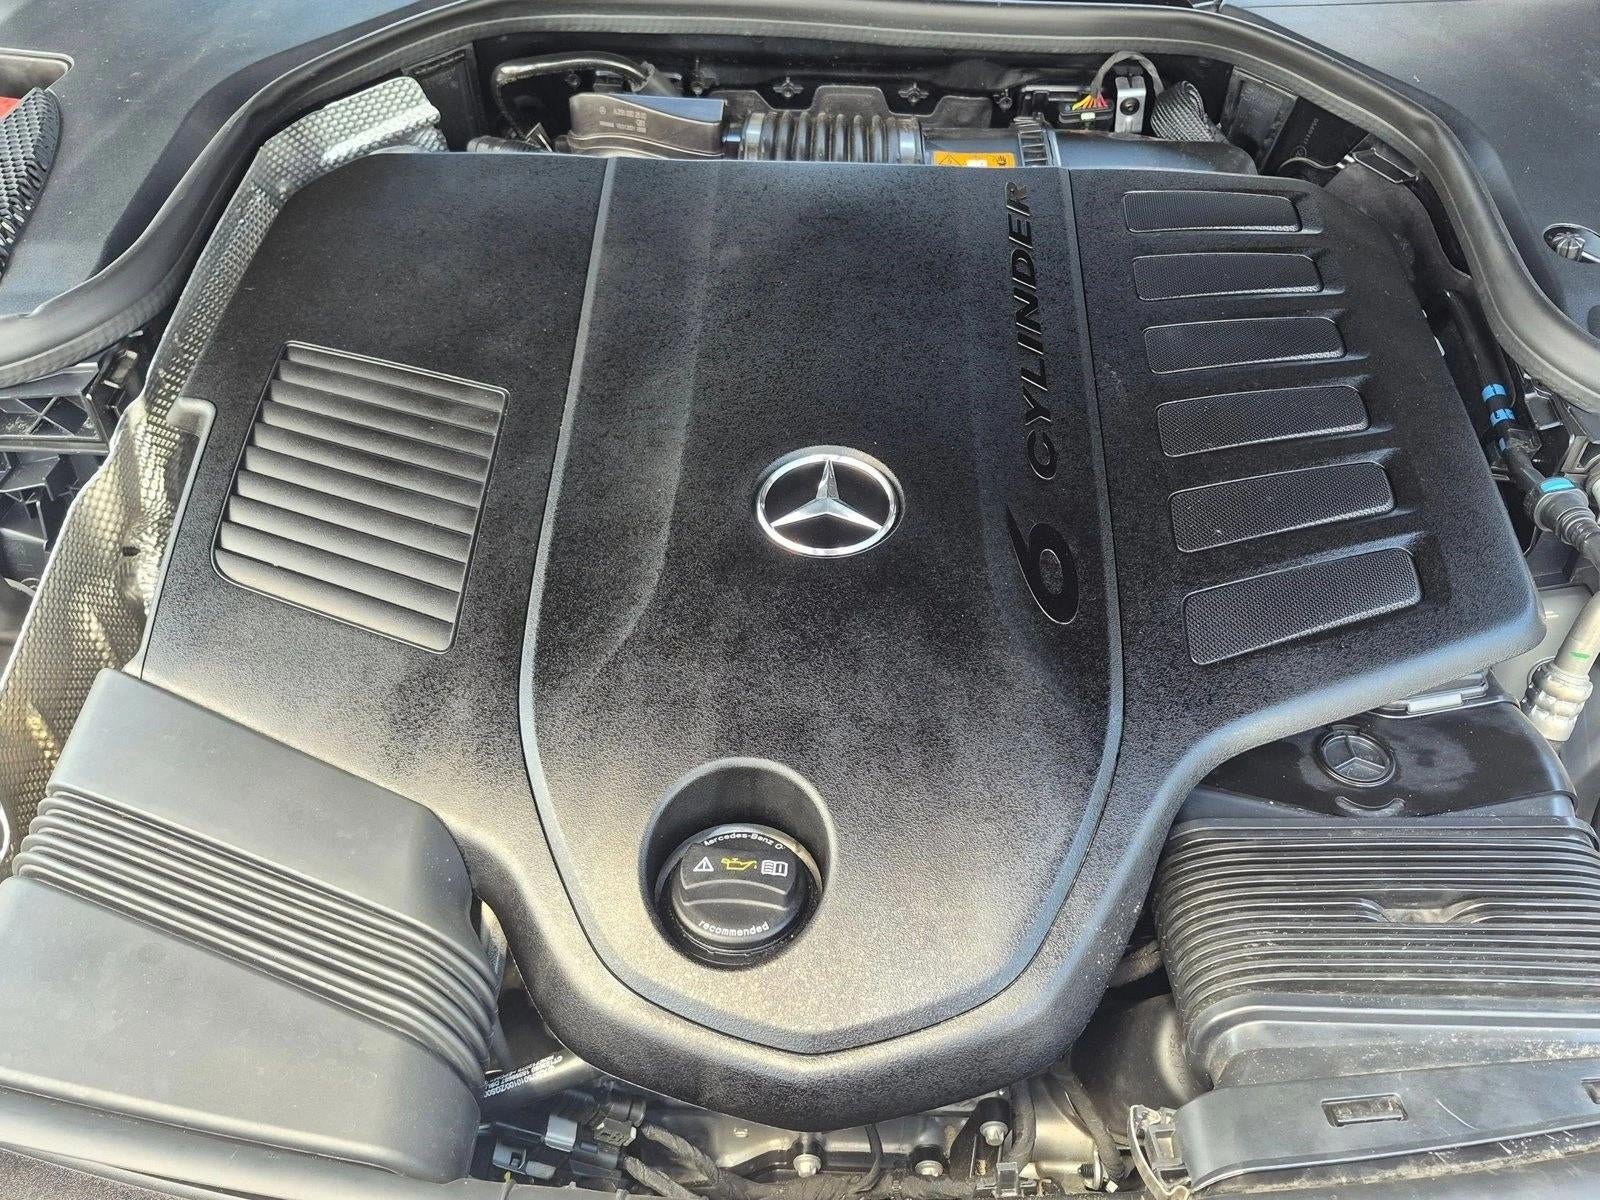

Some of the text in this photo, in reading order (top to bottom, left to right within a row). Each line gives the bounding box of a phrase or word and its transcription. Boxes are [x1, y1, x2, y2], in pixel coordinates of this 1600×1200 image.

[1005, 181, 1080, 625] 6 CYLINDER
[698, 921, 770, 937] recommended
